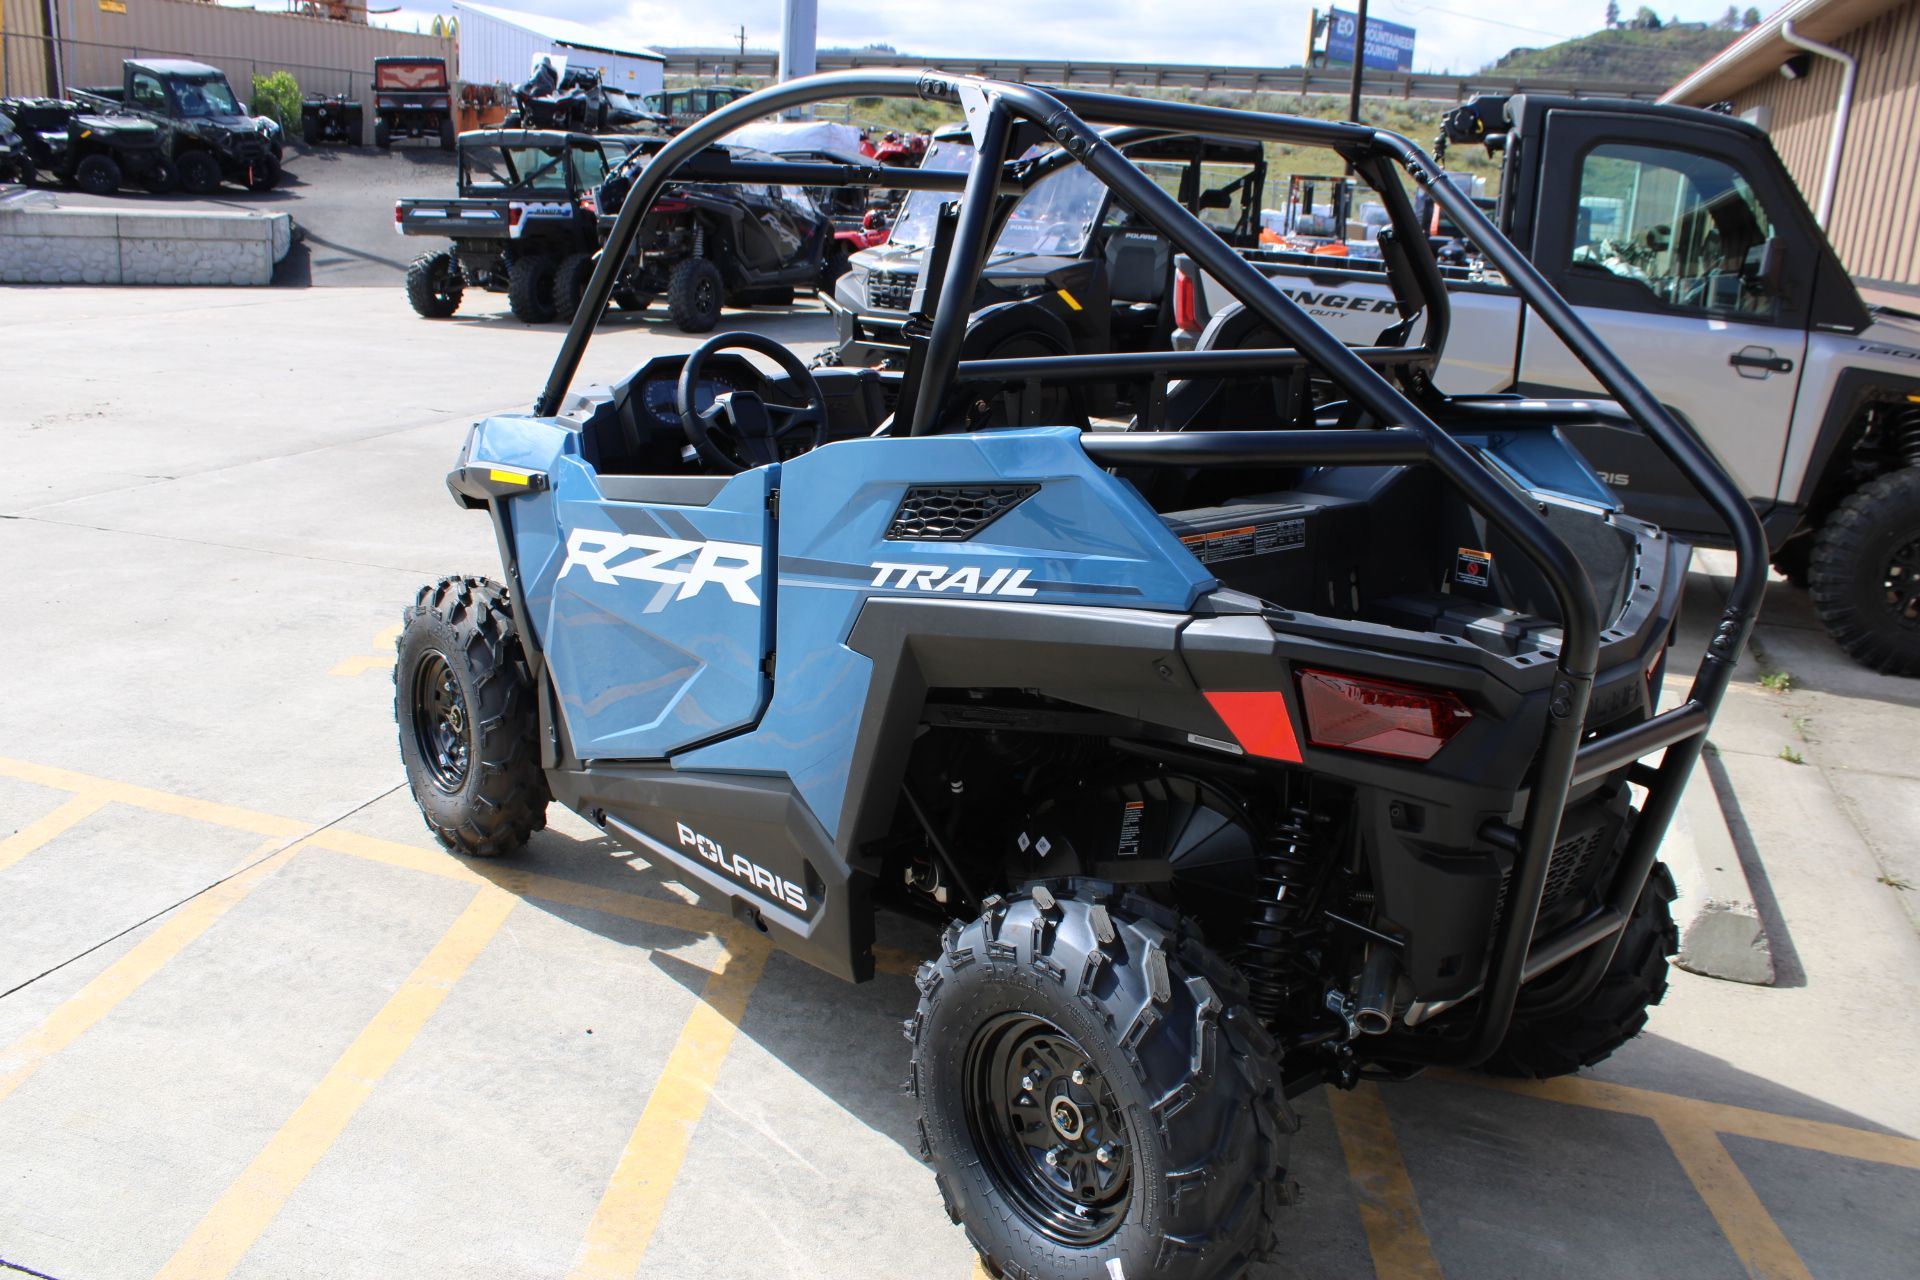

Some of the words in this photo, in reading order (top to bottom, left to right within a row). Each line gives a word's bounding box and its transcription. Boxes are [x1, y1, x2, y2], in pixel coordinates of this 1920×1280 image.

[1125, 232, 1158, 241] POLARIS
[1281, 289, 1398, 315] ANGER
[1309, 308, 1350, 319] DUTY
[1596, 471, 1630, 486] RIS
[557, 527, 762, 607] RZR
[870, 561, 1038, 597] TRAIL
[676, 821, 807, 911] POLARIS
